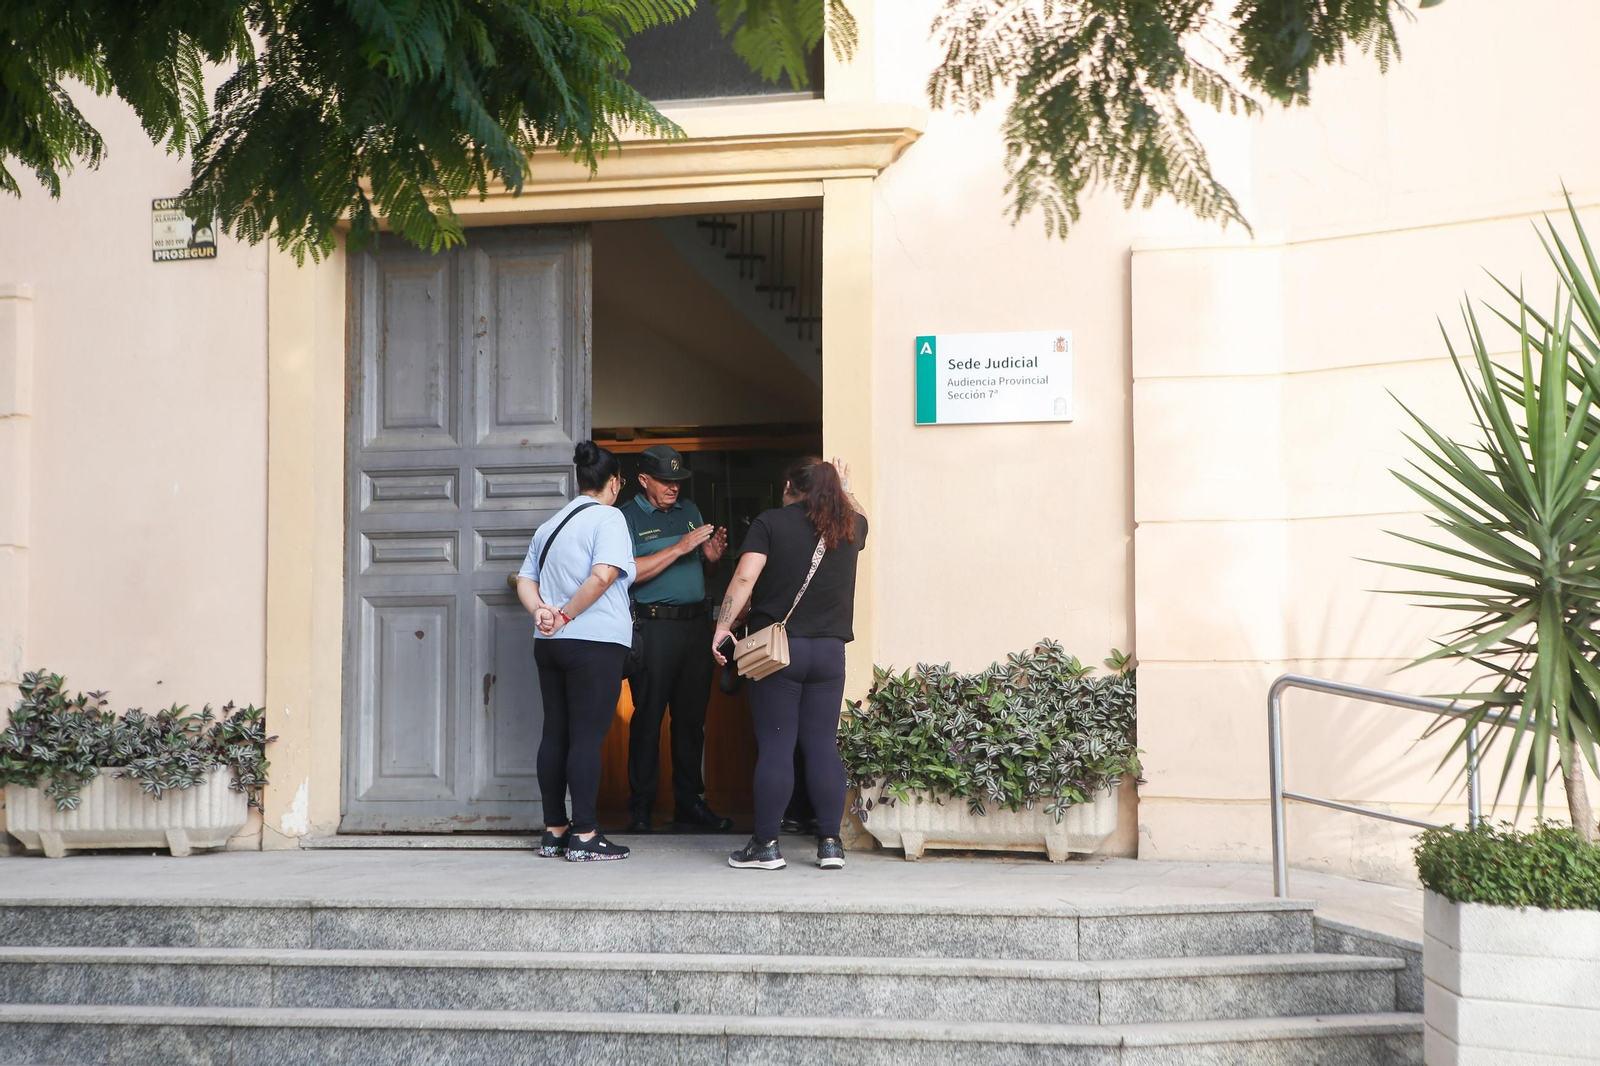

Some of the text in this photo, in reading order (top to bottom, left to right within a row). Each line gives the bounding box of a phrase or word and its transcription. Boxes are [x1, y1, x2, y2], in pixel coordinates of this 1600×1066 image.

[155, 247, 215, 260] PROSEGUR
[948, 356, 1039, 371] Sede Judicial
[947, 375, 1049, 387] Audiencia Provincial
[947, 389, 986, 400] Sección
